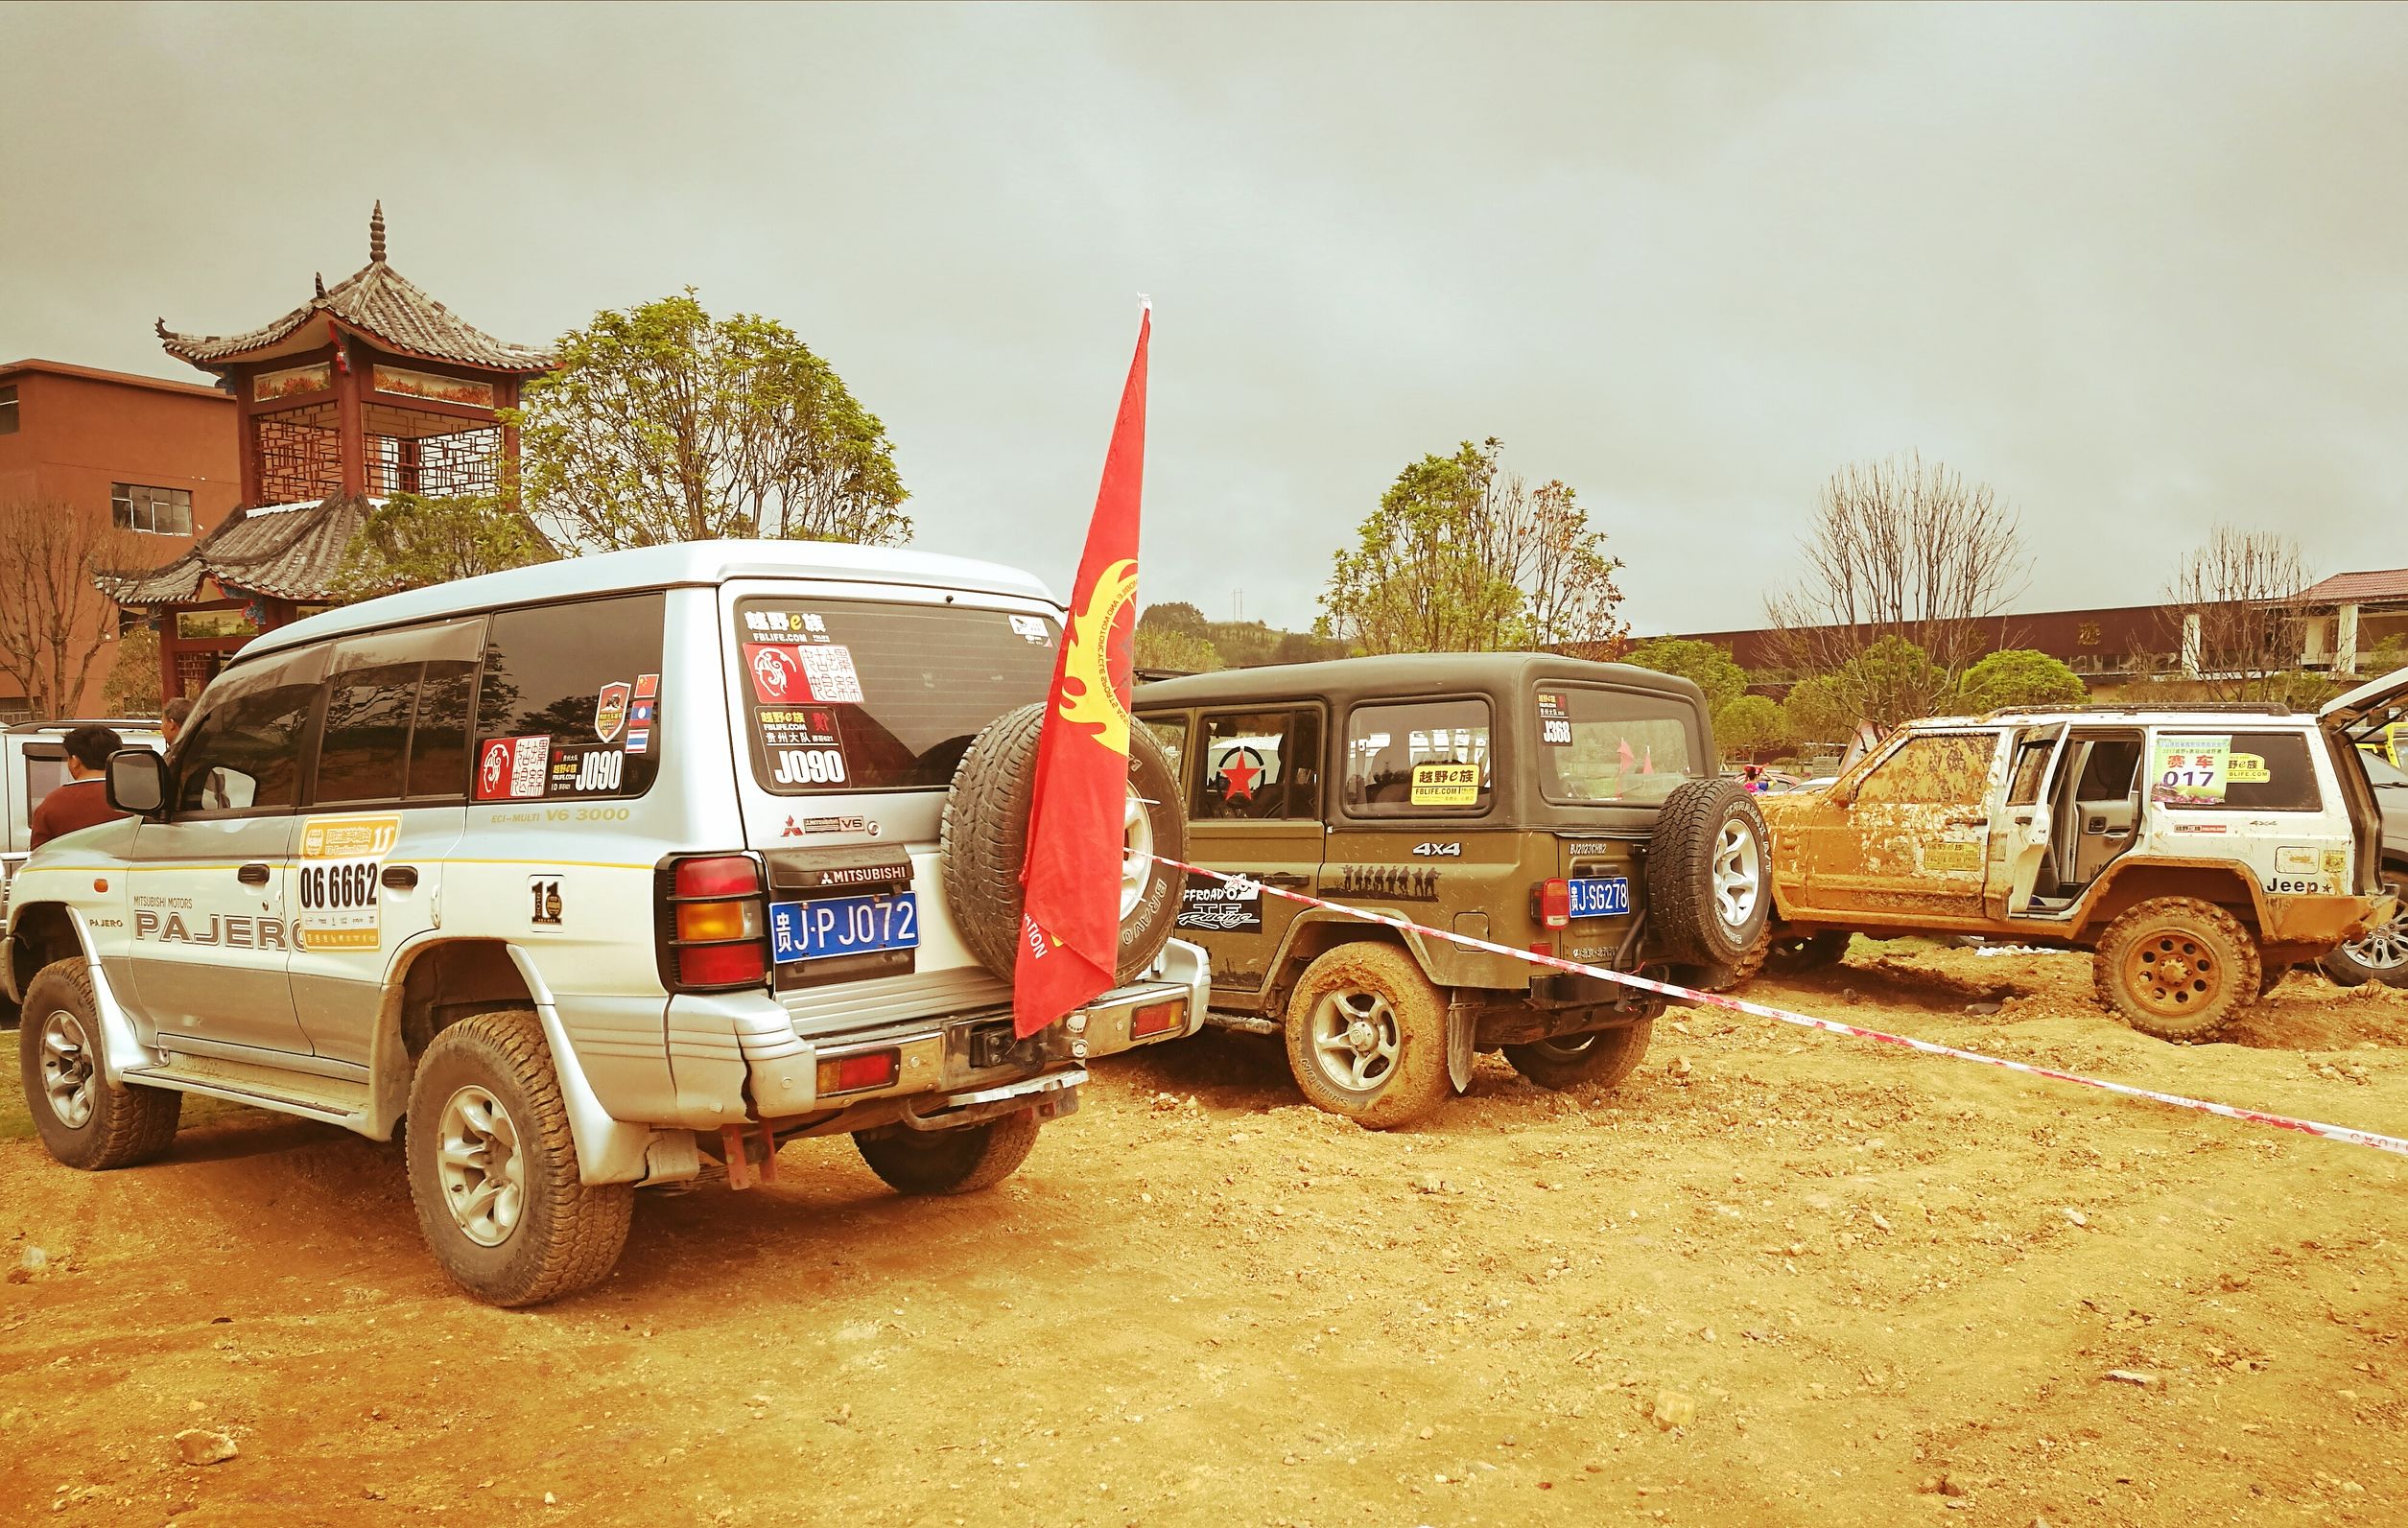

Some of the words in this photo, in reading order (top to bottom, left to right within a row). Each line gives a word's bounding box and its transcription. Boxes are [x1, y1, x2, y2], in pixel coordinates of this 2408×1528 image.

[753, 633, 807, 643] FBLIFE.COM
[766, 732, 812, 743] 贵州大队
[1543, 720, 1571, 743] J368
[774, 749, 845, 784] J090
[2167, 755, 2214, 768] 赛车
[2228, 760, 2258, 769] 野e族
[576, 749, 624, 791] J090
[1419, 770, 1474, 784] 越野e族
[2162, 771, 2214, 787] 017
[546, 809, 570, 821] V6
[576, 808, 630, 821] 3000
[841, 819, 862, 829] V6
[834, 866, 907, 883] MITSUBISHI
[2266, 878, 2319, 893] Jeep
[1183, 888, 1223, 902] FFROAD
[133, 896, 167, 908] MITSUBISHI
[167, 898, 193, 909] MOTORS
[1121, 878, 1168, 946] BRAVO
[89, 919, 124, 928] PAJERO
